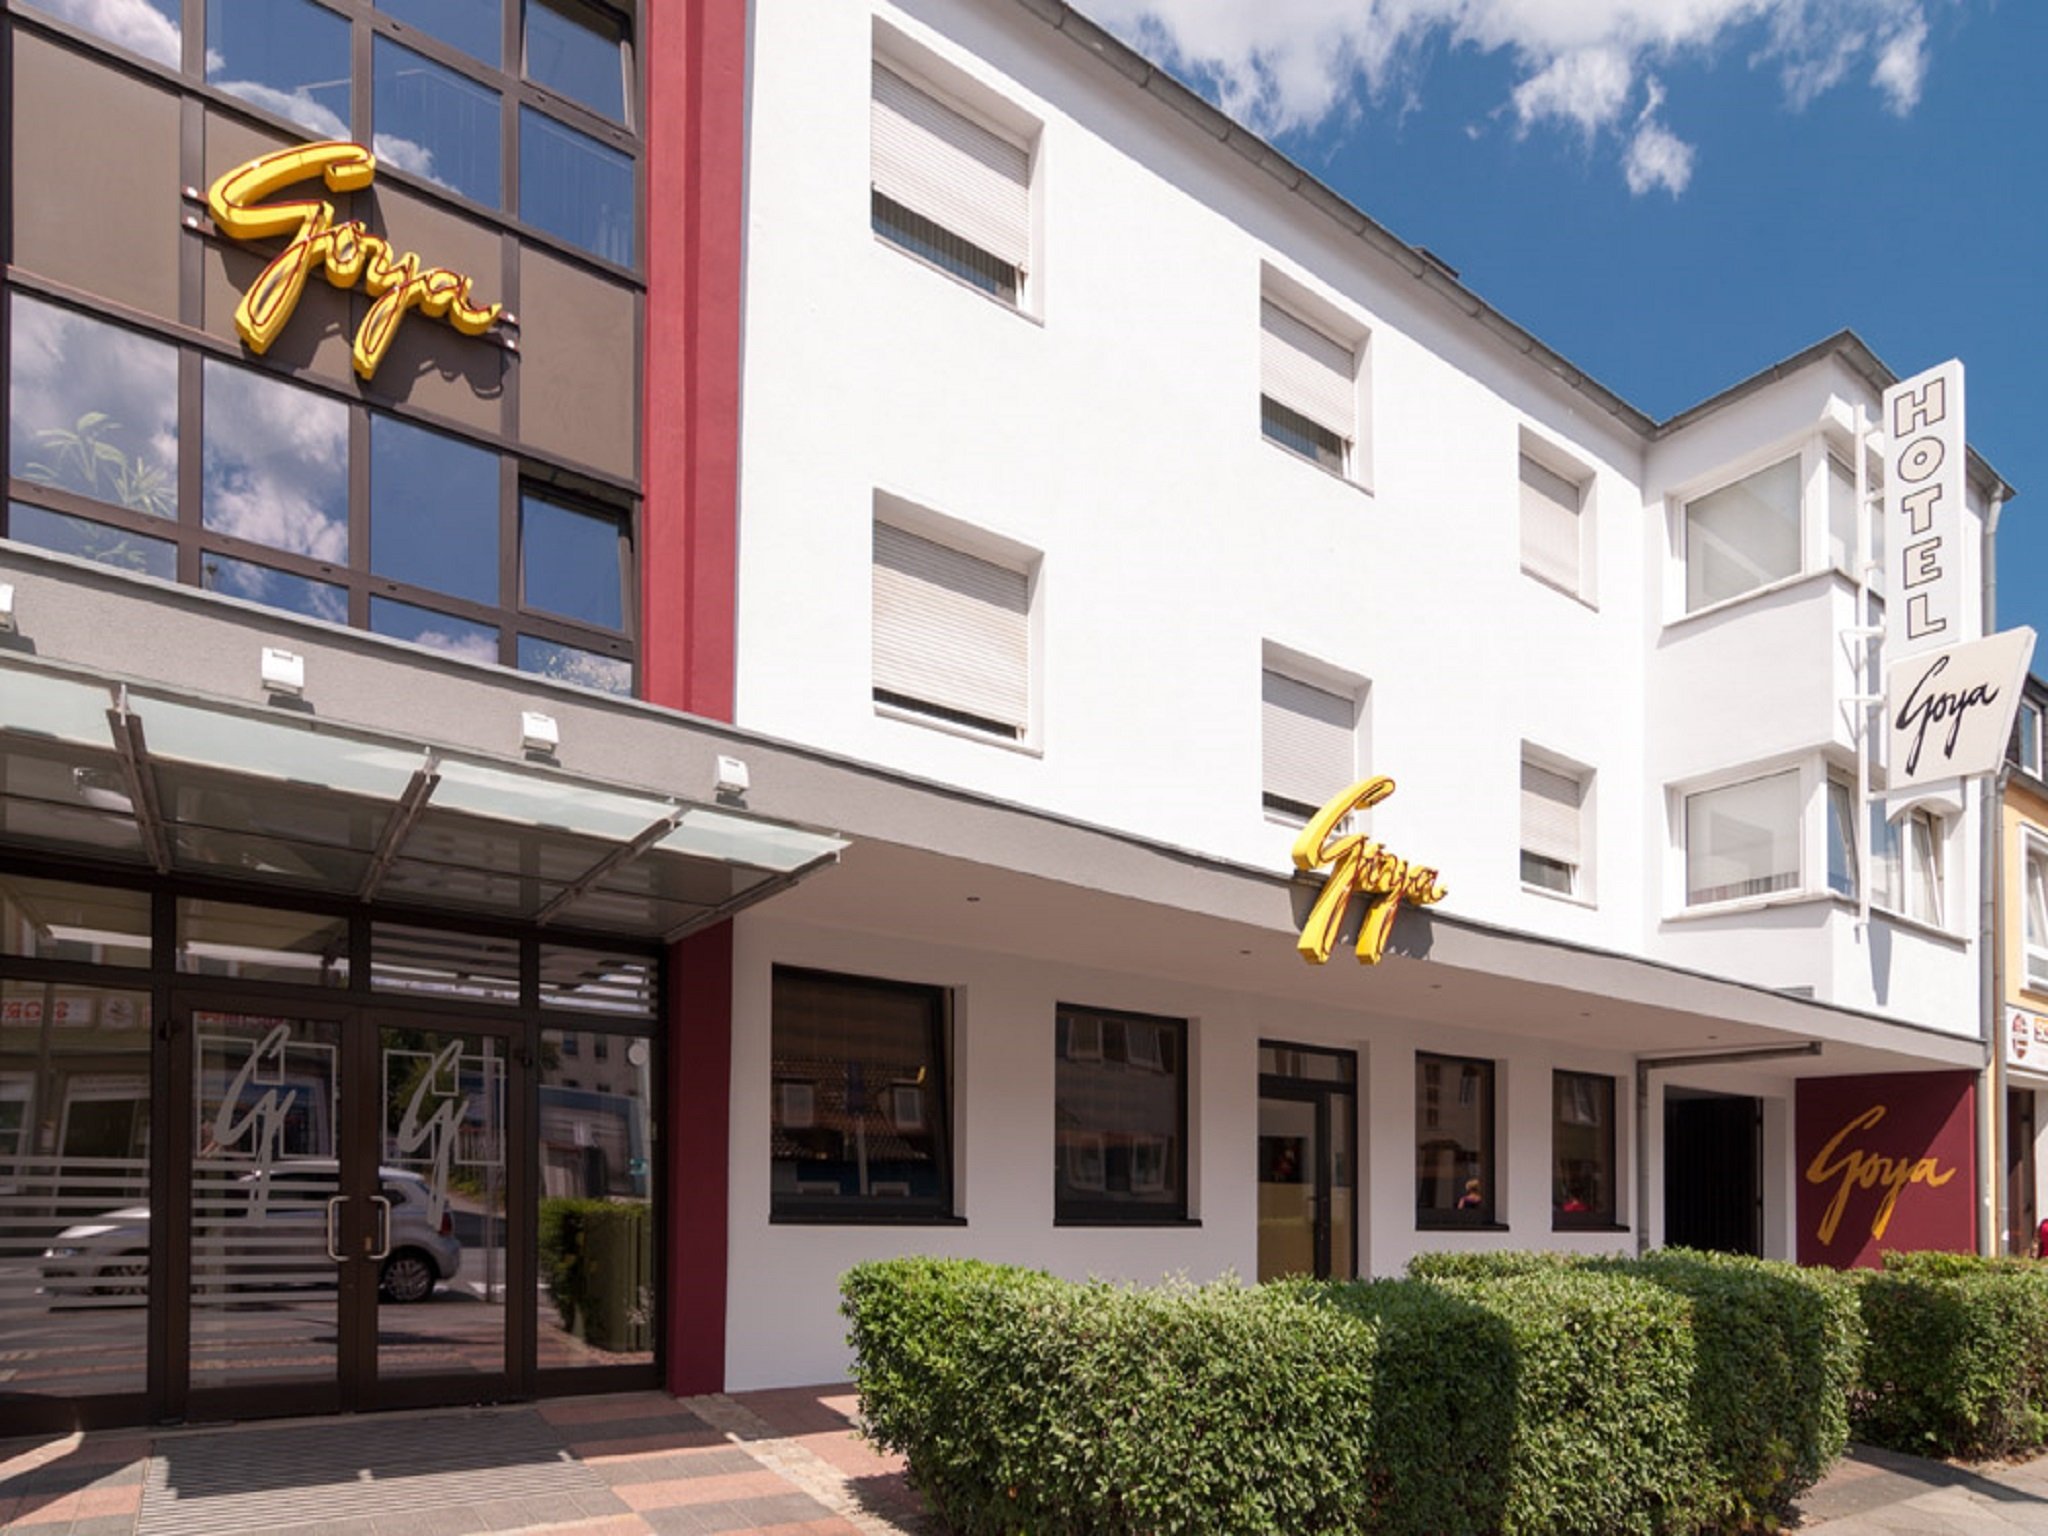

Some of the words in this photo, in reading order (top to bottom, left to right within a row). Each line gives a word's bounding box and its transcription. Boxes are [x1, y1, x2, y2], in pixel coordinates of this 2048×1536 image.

[208, 140, 502, 381] Goya
[1893, 376, 1947, 642] HOTEL
[1896, 655, 1999, 777] Goya
[1292, 775, 1449, 966] Goya
[1806, 1105, 1956, 1246] Goya
